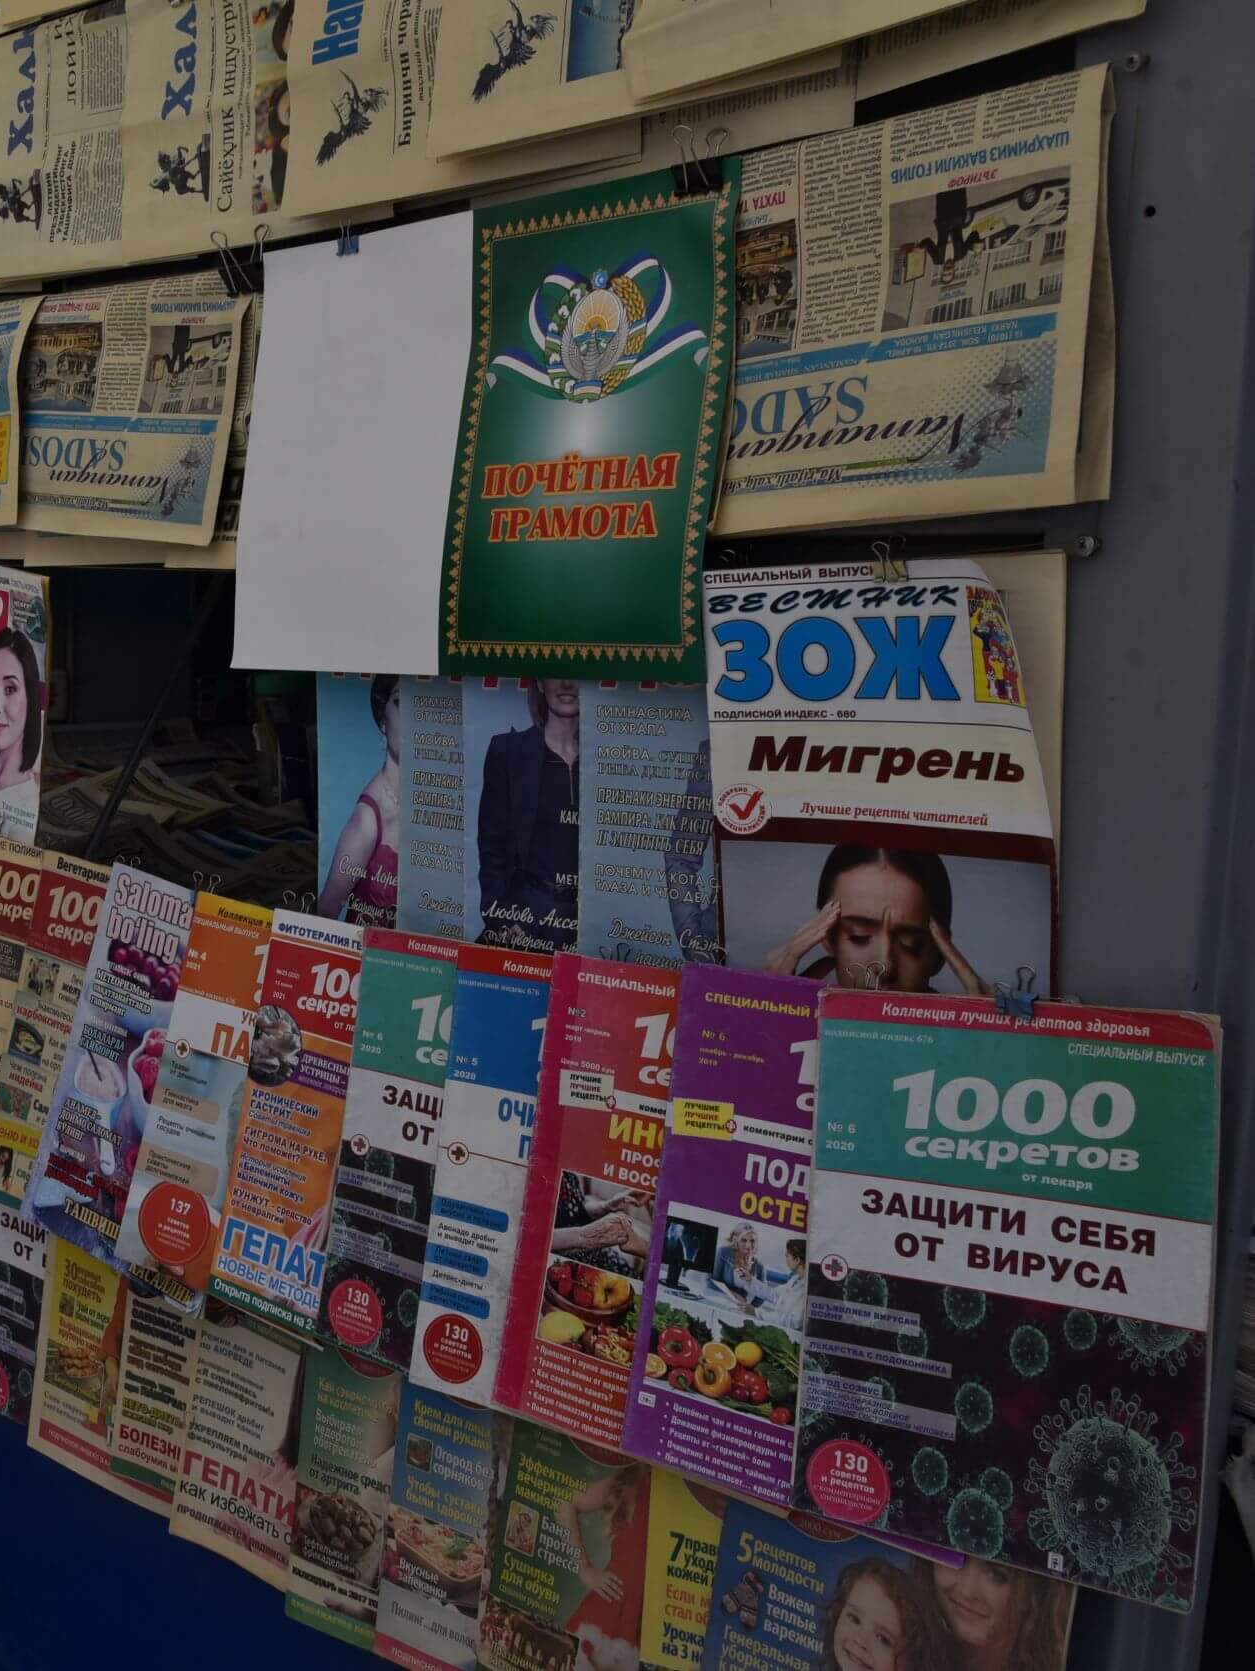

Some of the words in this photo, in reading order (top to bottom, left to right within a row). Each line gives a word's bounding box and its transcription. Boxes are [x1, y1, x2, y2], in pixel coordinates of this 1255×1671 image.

[398, 51, 415, 146] Биринчи
[67, 139, 77, 169] ДОИР
[988, 130, 1069, 160] ШАҲРИМИЗ
[217, 105, 239, 212] Сайёҳлик
[889, 158, 931, 183] ҒОЛИБ
[933, 147, 987, 172] ВАКИЛИ
[946, 167, 998, 188] ЭЪТИРОФ
[49, 142, 63, 242] ПРЕЗИДЕНТИНИНГ
[755, 189, 785, 206] ПУХТА
[62, 173, 73, 241] ТАШРИФИГА
[48, 468, 173, 504] Namangan
[482, 452, 682, 500] ПОЧЁТНАЯ
[487, 500, 658, 543] ГРАМОТА
[704, 568, 812, 585] СПЕЦИАЛЬНЫЙ
[708, 585, 960, 615] ВЕСТНИК
[712, 616, 962, 702] ЗОЖ
[597, 705, 692, 721] ГИМНАСТИКА
[714, 709, 781, 720] ПОДПИСНОЙ
[784, 709, 828, 719] ИНДЕКС
[837, 709, 857, 719] 680
[619, 725, 667, 736] ХРАПА
[748, 735, 1025, 783] Мигрень
[597, 788, 654, 806] ПРИЗНАКИ
[597, 809, 652, 829] ВАМПИРА:
[800, 802, 851, 817] Лучшие
[853, 806, 910, 821] рецепты
[912, 808, 989, 826] читателей
[339, 855, 367, 881] Софи
[595, 863, 653, 880] ПОЧЕМУ
[114, 872, 193, 931] Saloma
[482, 901, 534, 925] Любовь
[217, 906, 264, 927] Коллекция
[278, 922, 348, 947] ФИТОТЕРАПИЯ
[609, 918, 671, 946] Джейсон
[577, 970, 676, 998] СПЕЦИАЛЬНЫЙ
[704, 991, 811, 1018] СПЕЦИАЛЬНЫЙ
[881, 1002, 956, 1022] Коллекция
[960, 1008, 1012, 1028] лучших
[1015, 1013, 1083, 1033] рецептов
[1086, 1018, 1151, 1038] здоровья
[360, 1044, 382, 1054] 2020
[472, 1057, 478, 1066] 5
[1066, 1041, 1152, 1064] СПЕЦИАЛЬНЫЙ
[1155, 1049, 1206, 1068] ВЫПУСК
[8, 1071, 44, 1092] индейка
[299, 1064, 340, 1084] УСТРИЦЫ
[454, 1069, 475, 1080] 2020
[570, 1073, 602, 1084] ЛУЧШИЕ
[251, 1088, 320, 1118] ХРОНИЧЕСКИЙ
[570, 1091, 607, 1102] РЕЦЕПТЫ
[684, 1102, 720, 1113] ЛУЧШИЕ
[892, 1068, 1136, 1140] 1000
[244, 1126, 288, 1147] ГИГРОМА
[401, 1121, 435, 1146] ОТ
[685, 1119, 726, 1131] РЕЦЕПТЫ
[742, 1124, 806, 1144] коментарии
[825, 1139, 855, 1153] 2020
[904, 1134, 1140, 1173] секретов
[1041, 1174, 1094, 1192] лекаря
[169, 1197, 192, 1216] 137
[739, 1191, 807, 1226] ОСТЕ
[861, 1188, 1027, 1237] ЗАЩИТИ
[1050, 1216, 1156, 1257] СЕБЯ
[12, 1241, 34, 1261] ОТ
[222, 1217, 326, 1288] ГЕПАТ
[894, 1232, 944, 1263] ОТ
[966, 1243, 1129, 1295] ВИРУСА
[218, 1256, 268, 1286] НОВЫЕ
[214, 1278, 252, 1304] Открыта
[254, 1296, 292, 1322] подписка
[347, 1288, 369, 1307] 130
[444, 1322, 469, 1342] 130
[875, 1352, 948, 1376] ПОДОКОННИКА
[808, 1374, 841, 1391] МЕТОД
[673, 1402, 710, 1421] Целебные
[669, 1428, 700, 1445] Рецепты
[671, 1416, 709, 1435] Домашние
[434, 1444, 474, 1471] Огород
[667, 1440, 704, 1460] Очищение
[833, 1449, 869, 1473] 130
[182, 1450, 296, 1527] ГЕПАТИ
[431, 1463, 486, 1491] сорняков
[517, 1470, 574, 1501] вечерний
[178, 1481, 207, 1500] как
[209, 1492, 281, 1537] избежать
[540, 1516, 572, 1542] Баня
[539, 1534, 582, 1560] против
[669, 1531, 685, 1562] 7
[736, 1531, 755, 1564] 5
[753, 1539, 816, 1573] рецептов
[398, 1557, 440, 1584] Вкусные
[503, 1552, 555, 1586] Сушилка
[537, 1549, 581, 1575] стресса
[667, 1565, 710, 1585] кожей
[751, 1556, 826, 1595] молодости
[525, 1580, 561, 1604] обуви
[666, 1583, 696, 1603] Если
[767, 1583, 815, 1616] Вяжем
[764, 1602, 817, 1634] теплые
[722, 1624, 810, 1671] Генеральная
[763, 1621, 825, 1654] варежки
